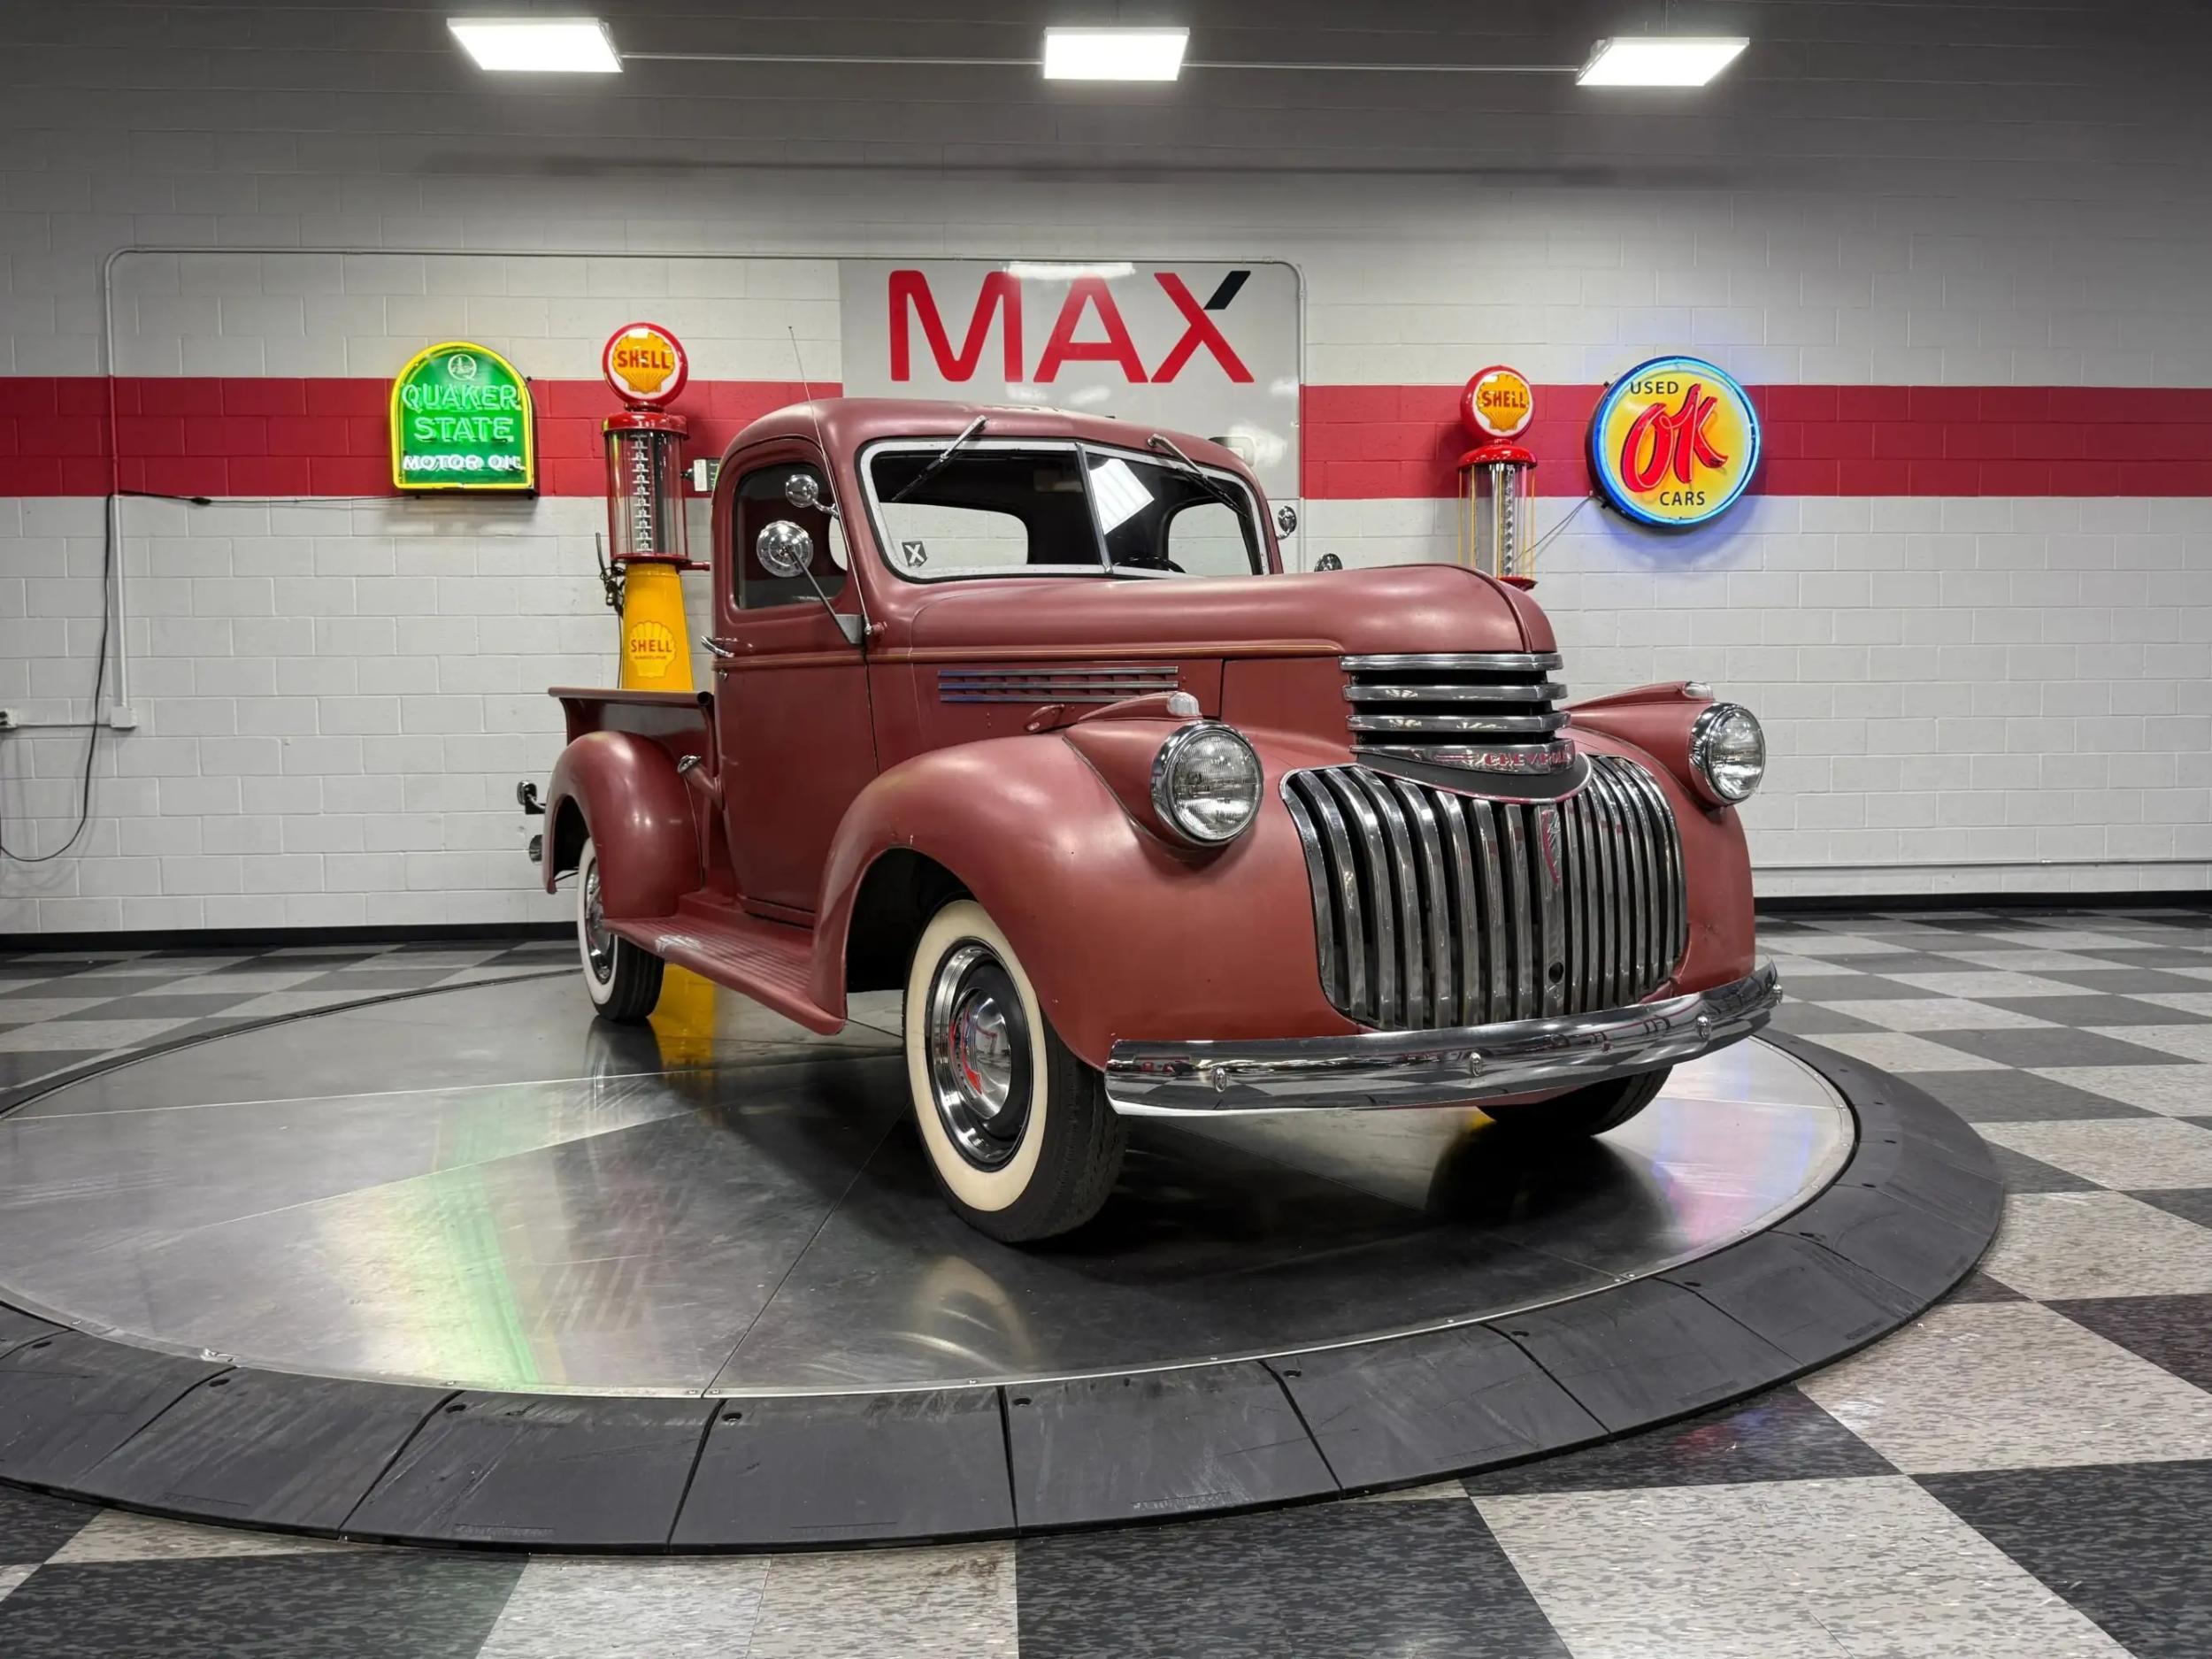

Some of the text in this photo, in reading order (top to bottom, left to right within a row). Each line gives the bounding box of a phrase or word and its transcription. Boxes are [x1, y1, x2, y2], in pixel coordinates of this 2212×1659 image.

[888, 270, 1255, 383] MAX
[617, 350, 671, 370] SHELL
[402, 383, 522, 413] QUAKER
[1630, 381, 1679, 395] USED
[1481, 389, 1527, 409] SHELL
[414, 416, 515, 442] STATE
[1620, 383, 1729, 493] OK
[403, 454, 526, 471] MOTOR OIL
[1660, 491, 1705, 506] CARS
[630, 639, 672, 652] SHELL
